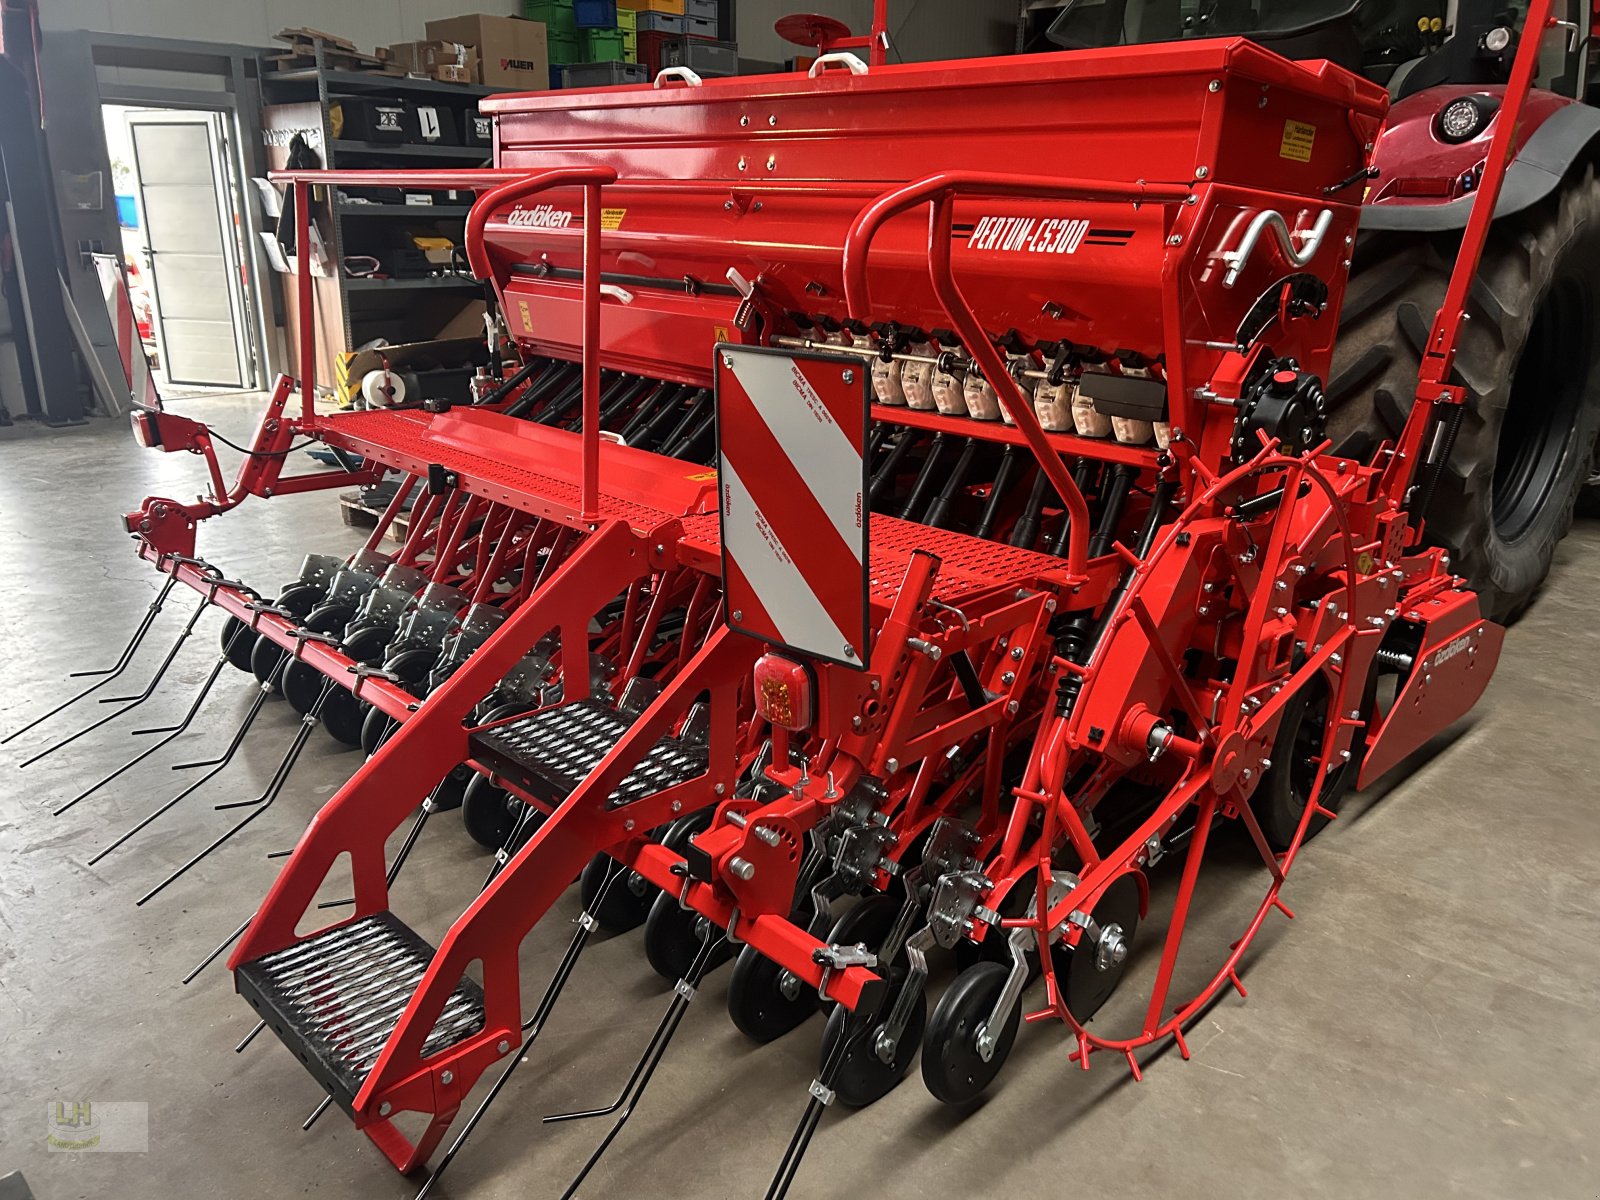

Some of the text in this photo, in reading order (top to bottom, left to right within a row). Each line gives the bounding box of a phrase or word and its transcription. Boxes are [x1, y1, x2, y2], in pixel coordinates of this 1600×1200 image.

[381, 113, 397, 127] 26
[507, 204, 572, 228] özdöken
[967, 216, 1090, 254] PERTUM-CS300
[1434, 636, 1470, 667] özdöken
